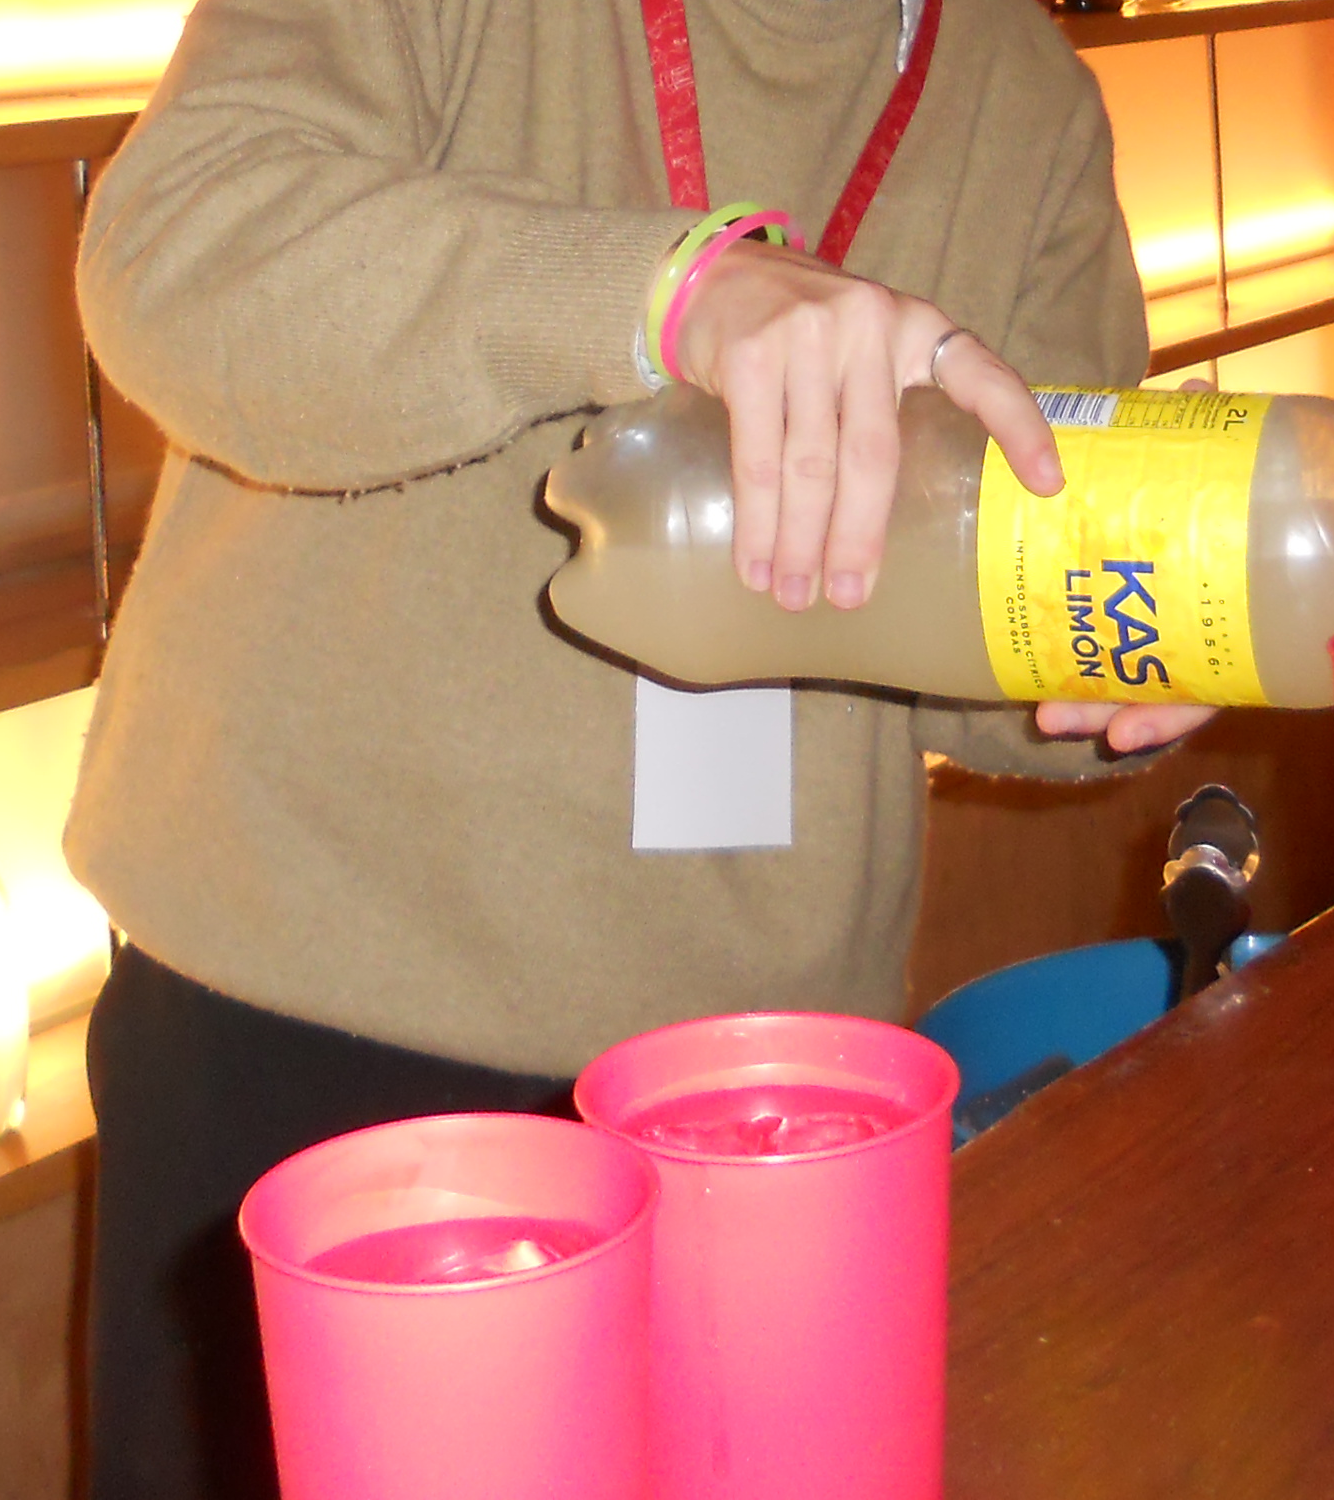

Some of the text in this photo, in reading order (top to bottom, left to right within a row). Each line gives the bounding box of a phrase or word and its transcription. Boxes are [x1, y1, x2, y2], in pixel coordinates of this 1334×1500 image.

[1222, 408, 1249, 432] 2L
[1015, 539, 1026, 601] INTENSO
[1005, 596, 1022, 655] CON GAS
[1018, 605, 1032, 647] SABOR
[1064, 568, 1106, 679] LIMÓN
[1101, 559, 1171, 687] KAS
[1200, 599, 1220, 666] 1956
